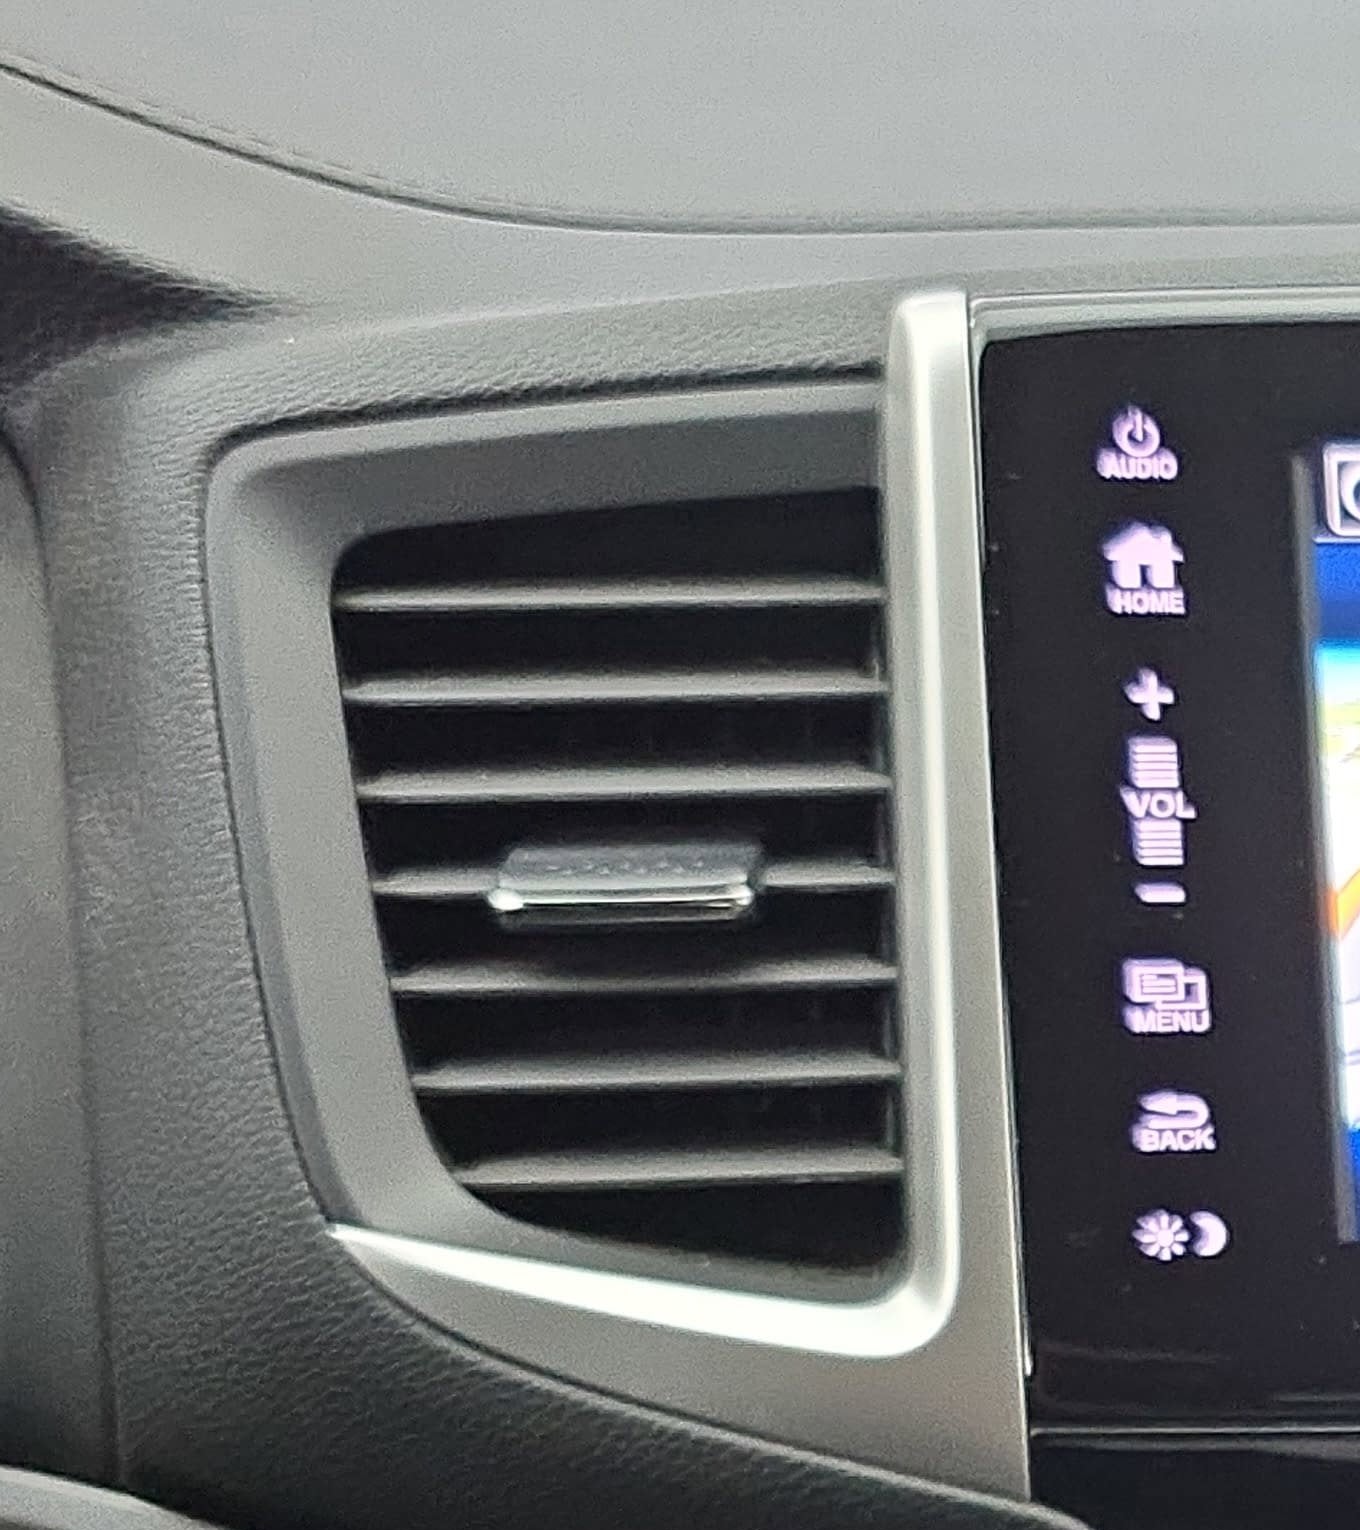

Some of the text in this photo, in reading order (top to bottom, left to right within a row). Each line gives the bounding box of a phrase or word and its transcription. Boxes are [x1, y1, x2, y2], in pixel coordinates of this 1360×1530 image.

[1099, 453, 1178, 481] AUDIO
[1106, 587, 1187, 614] HOME
[1122, 787, 1196, 819] VOL
[1124, 1007, 1210, 1034] MENU
[1132, 1126, 1216, 1152] BACK
